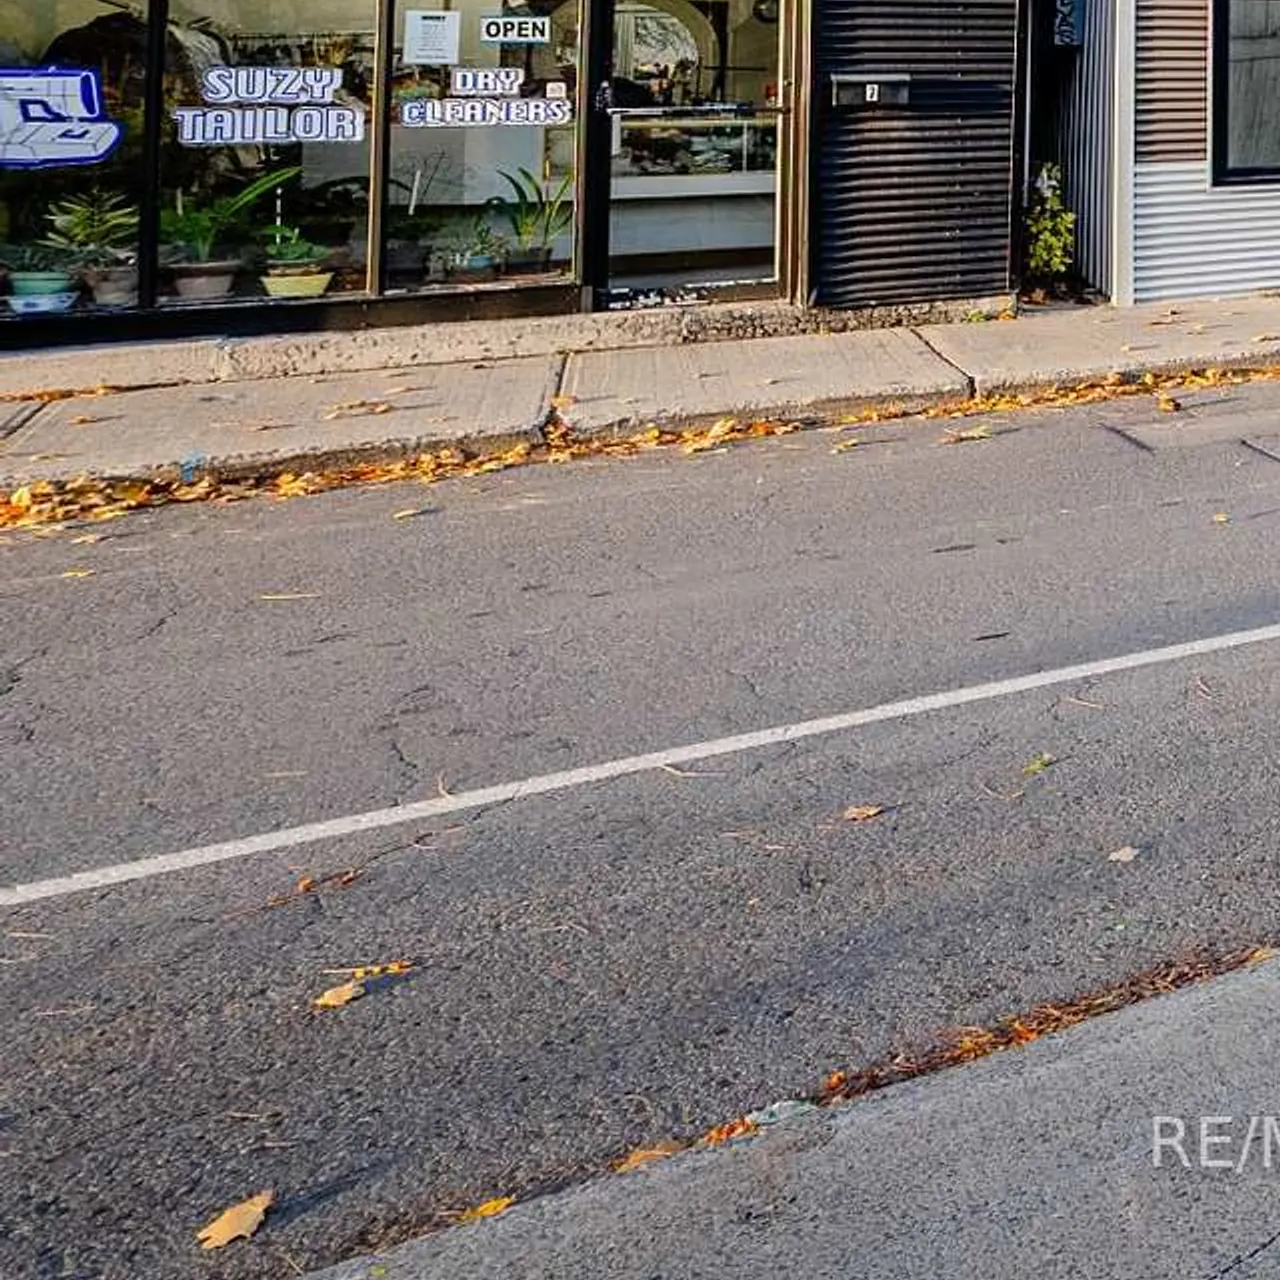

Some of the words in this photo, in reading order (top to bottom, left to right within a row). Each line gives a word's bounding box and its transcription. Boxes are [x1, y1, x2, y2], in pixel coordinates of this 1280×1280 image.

[485, 21, 546, 39] OPEN
[202, 66, 342, 104] SUZY
[452, 69, 525, 96] DRY
[174, 107, 367, 144] TAILOR
[402, 99, 573, 128] CLEANERS
